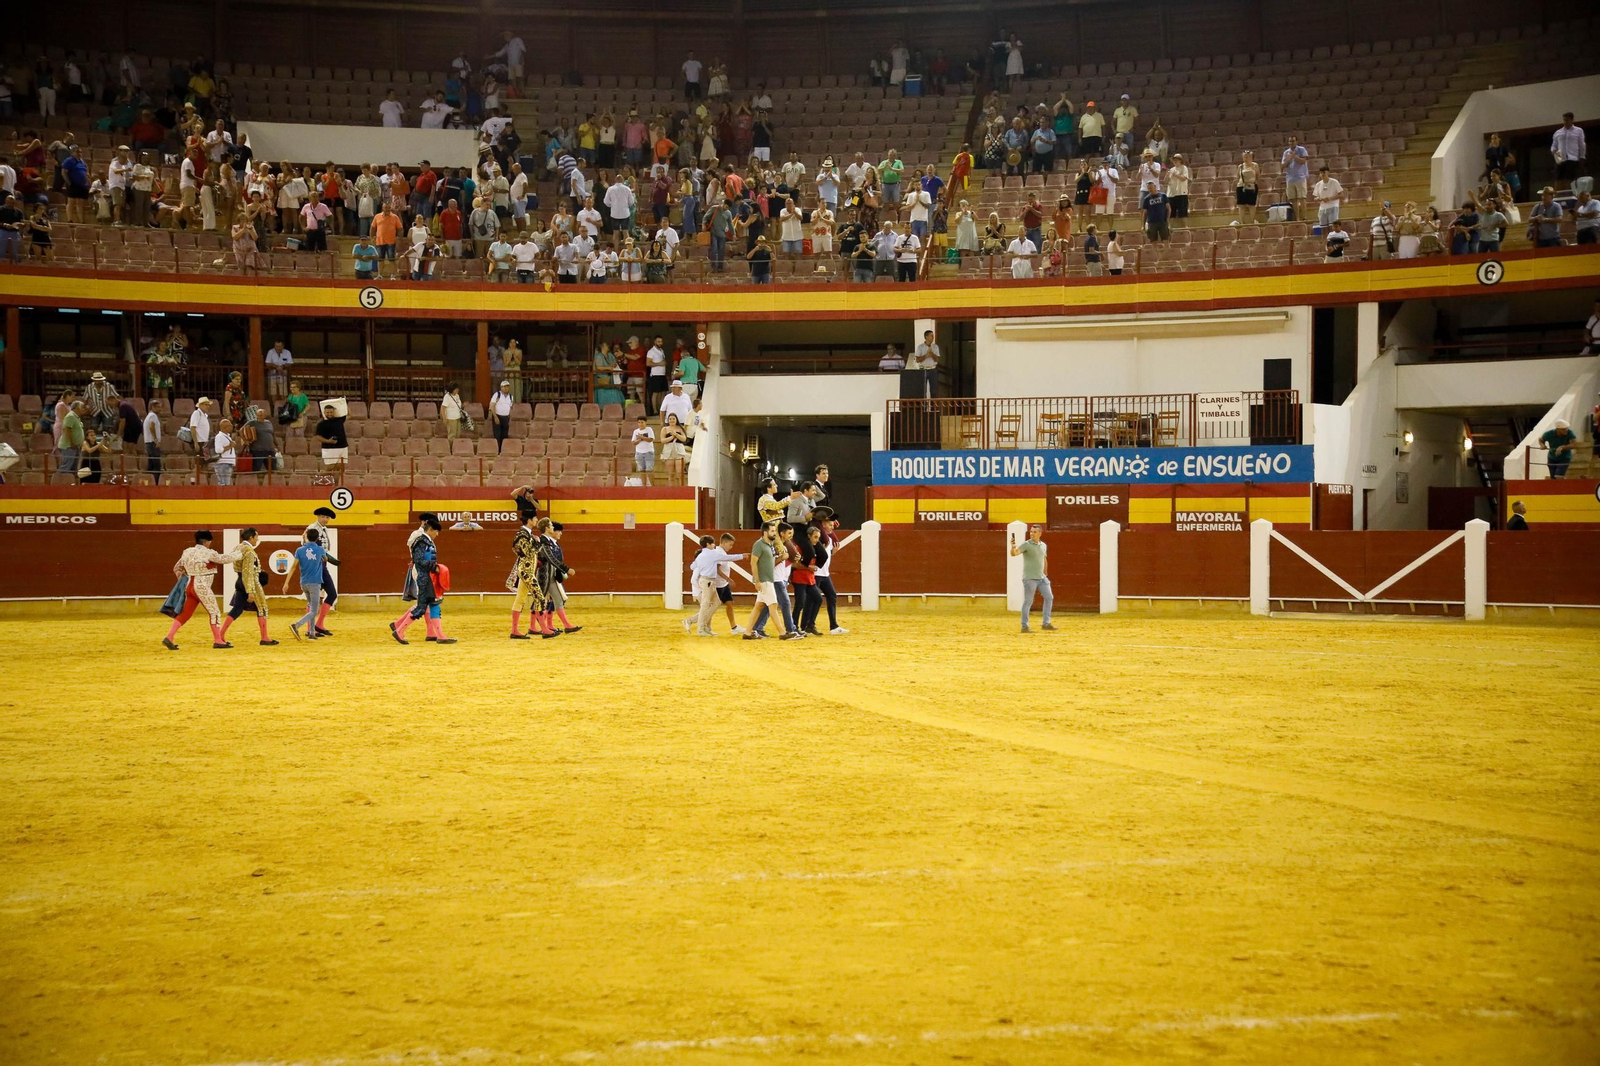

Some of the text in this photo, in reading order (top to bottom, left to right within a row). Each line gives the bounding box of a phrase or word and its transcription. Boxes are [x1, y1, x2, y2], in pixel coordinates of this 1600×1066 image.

[1484, 264, 1496, 281] 6
[366, 291, 377, 306] 5
[1200, 396, 1240, 404] CLARINES
[1200, 410, 1241, 418] TIMBALES
[891, 456, 976, 480] ROQUETAS
[979, 456, 1002, 478] DE
[1004, 455, 1045, 478] MAR
[1156, 459, 1179, 476] de
[1183, 452, 1292, 478] ENSUEÑO
[1328, 484, 1345, 494] PUERTA
[337, 491, 347, 506] 5
[1055, 495, 1120, 505] TORILES
[5, 515, 98, 525] MEDICOS
[437, 512, 518, 522] MULLLEROS
[918, 511, 983, 521] TORILERO
[1175, 512, 1243, 522] MAYORAL
[1176, 521, 1243, 532] ENFERMERÍA
